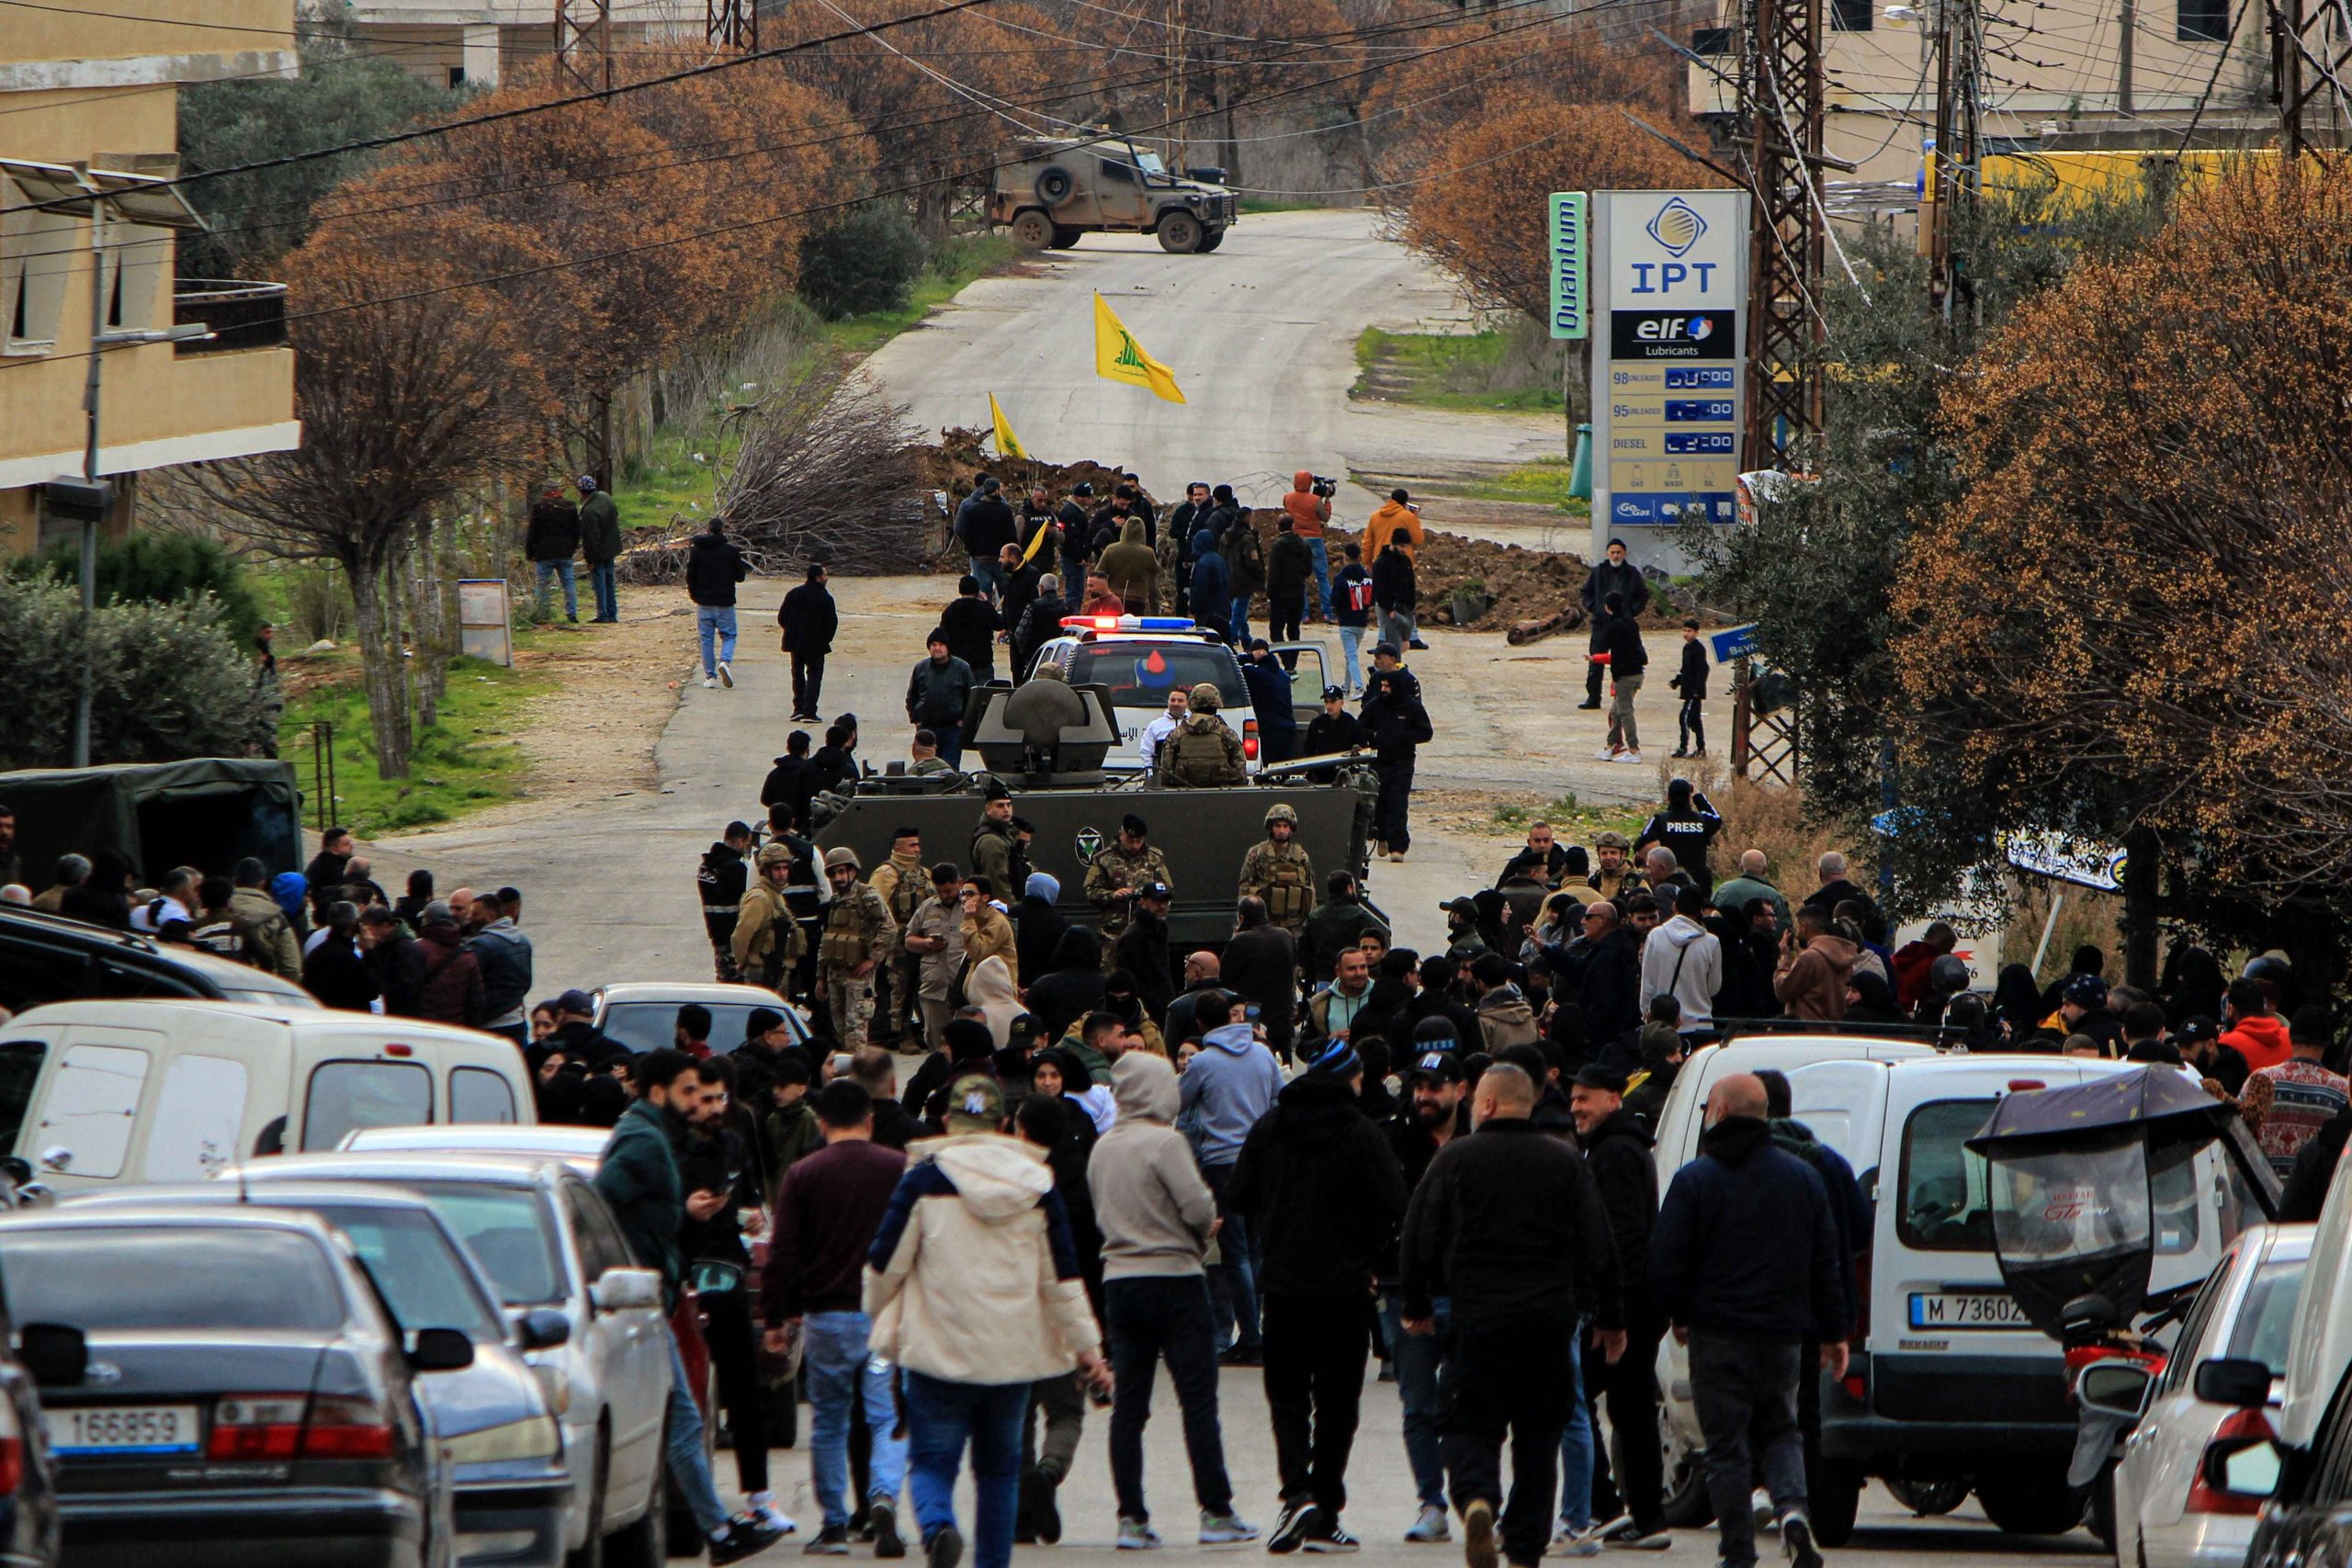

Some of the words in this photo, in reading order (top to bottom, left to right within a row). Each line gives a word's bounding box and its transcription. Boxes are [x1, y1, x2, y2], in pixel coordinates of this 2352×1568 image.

[1555, 200, 1577, 330] Quantum
[1631, 263, 1717, 293] IPT
[1636, 318, 1686, 339] elf
[1645, 346, 1699, 355] Lubricants
[1613, 372, 1628, 385] 98
[1613, 404, 1628, 417] 95
[1613, 438, 1647, 449] DIESEL
[1667, 822, 1704, 832] PRESS
[1416, 1039, 1454, 1051] PRESS
[1928, 1298, 1944, 1321] M
[1956, 1298, 2030, 1321] 73602
